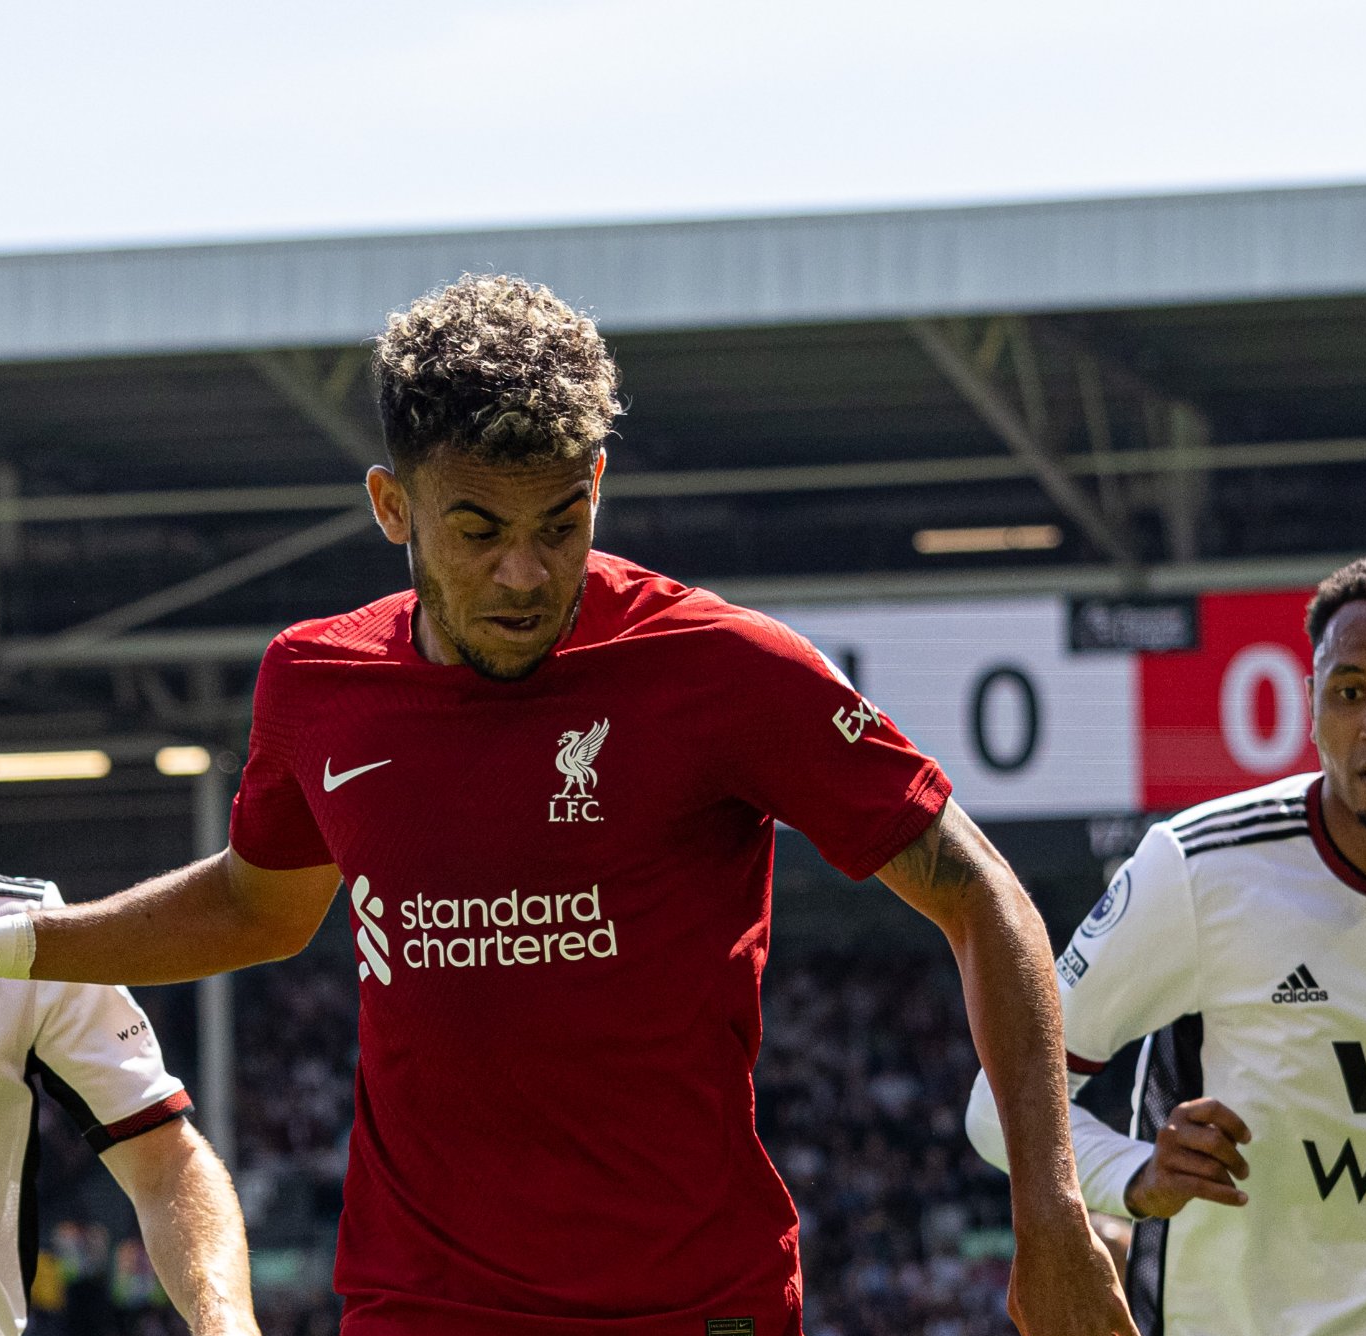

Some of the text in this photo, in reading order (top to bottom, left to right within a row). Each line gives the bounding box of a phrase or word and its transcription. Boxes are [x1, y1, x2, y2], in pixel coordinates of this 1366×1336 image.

[971, 643, 1307, 775] 0 0
[400, 884, 602, 930] standard
[402, 919, 618, 969] chartered
[1271, 988, 1329, 1004] adidas
